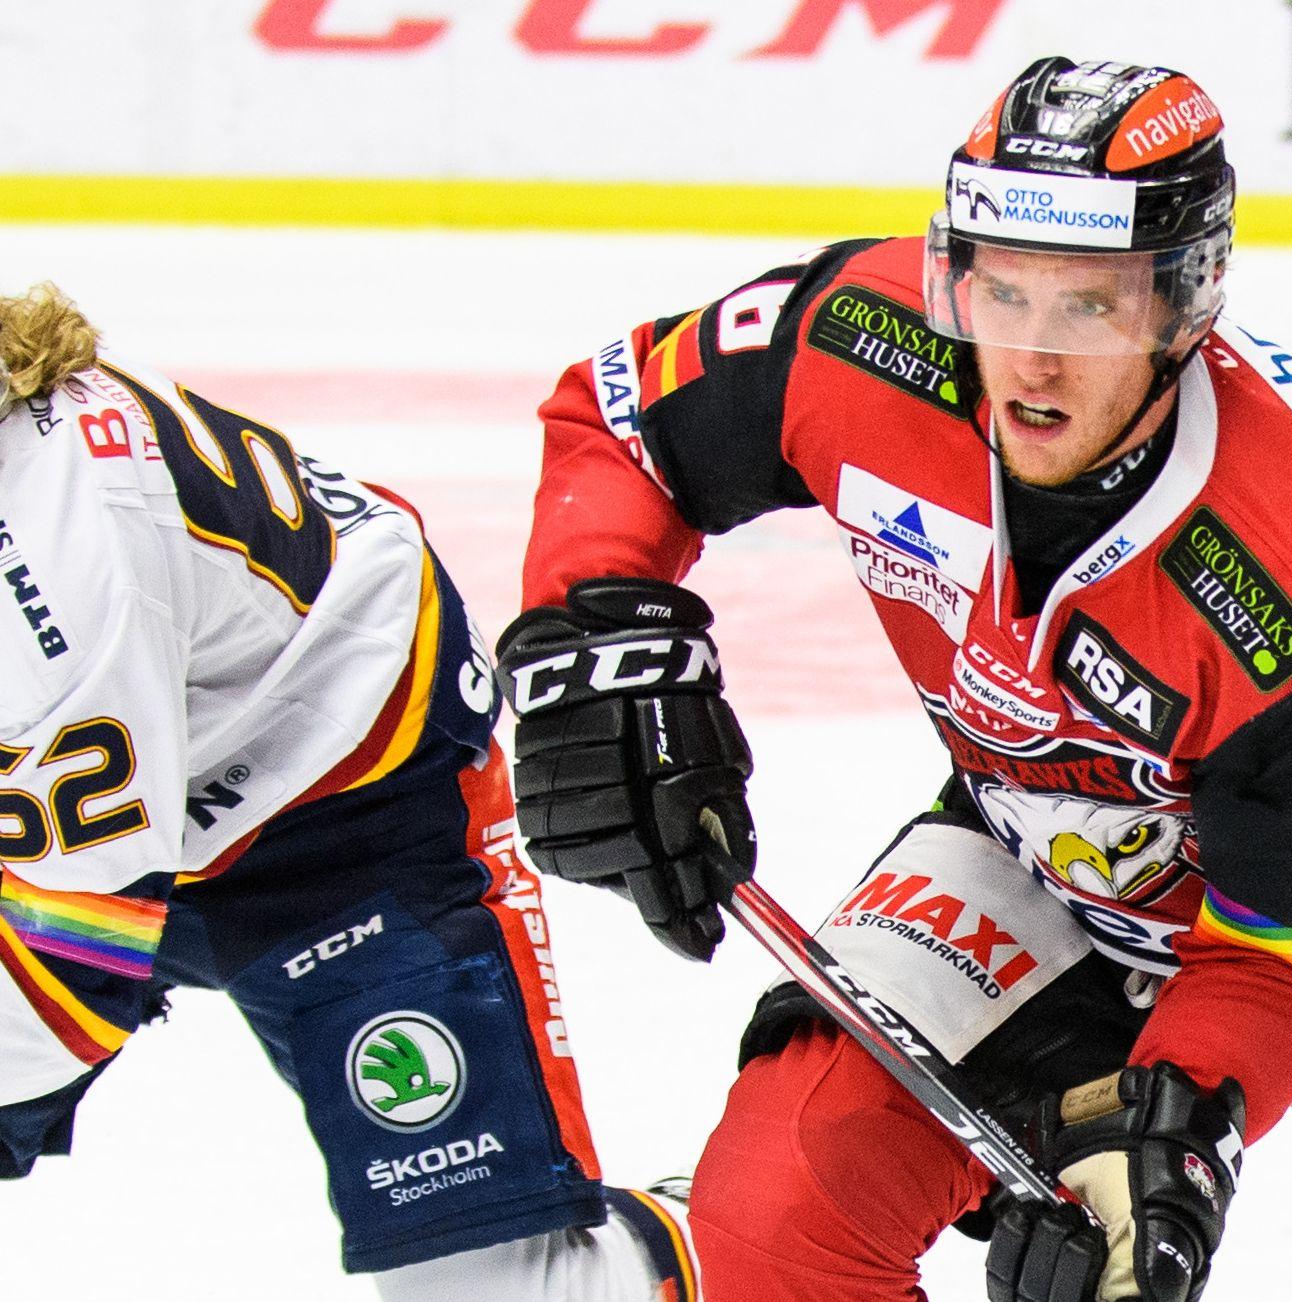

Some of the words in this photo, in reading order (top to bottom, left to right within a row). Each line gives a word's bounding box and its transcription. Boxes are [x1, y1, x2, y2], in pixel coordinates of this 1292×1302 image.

[1005, 137, 1090, 162] CCM
[1003, 204, 1130, 232] MAGNUSSON
[1005, 187, 1054, 207] OTTO
[831, 295, 957, 370] GRÖNSAK
[852, 332, 947, 392] HUSET
[871, 510, 950, 561] ERLANDSSON
[1073, 534, 1136, 586] bergx
[850, 536, 960, 616] Prioritet
[867, 565, 947, 626] Finans
[4, 563, 69, 660] BTM
[635, 603, 672, 620] HETTA
[1191, 568, 1269, 654] HUSET
[511, 639, 722, 715] CCM
[961, 668, 1055, 728] MonkeySports
[968, 642, 1047, 699] CCM
[1067, 630, 1152, 733] RSA
[282, 914, 384, 979] CCM
[842, 873, 1039, 992] MAXI
[856, 912, 1002, 1001] STORMARKNAD
[823, 963, 932, 1059] CCM
[976, 1108, 1016, 1148] LASSEN
[366, 1132, 505, 1190] ŠKODA
[389, 1165, 491, 1206] Stockholm
